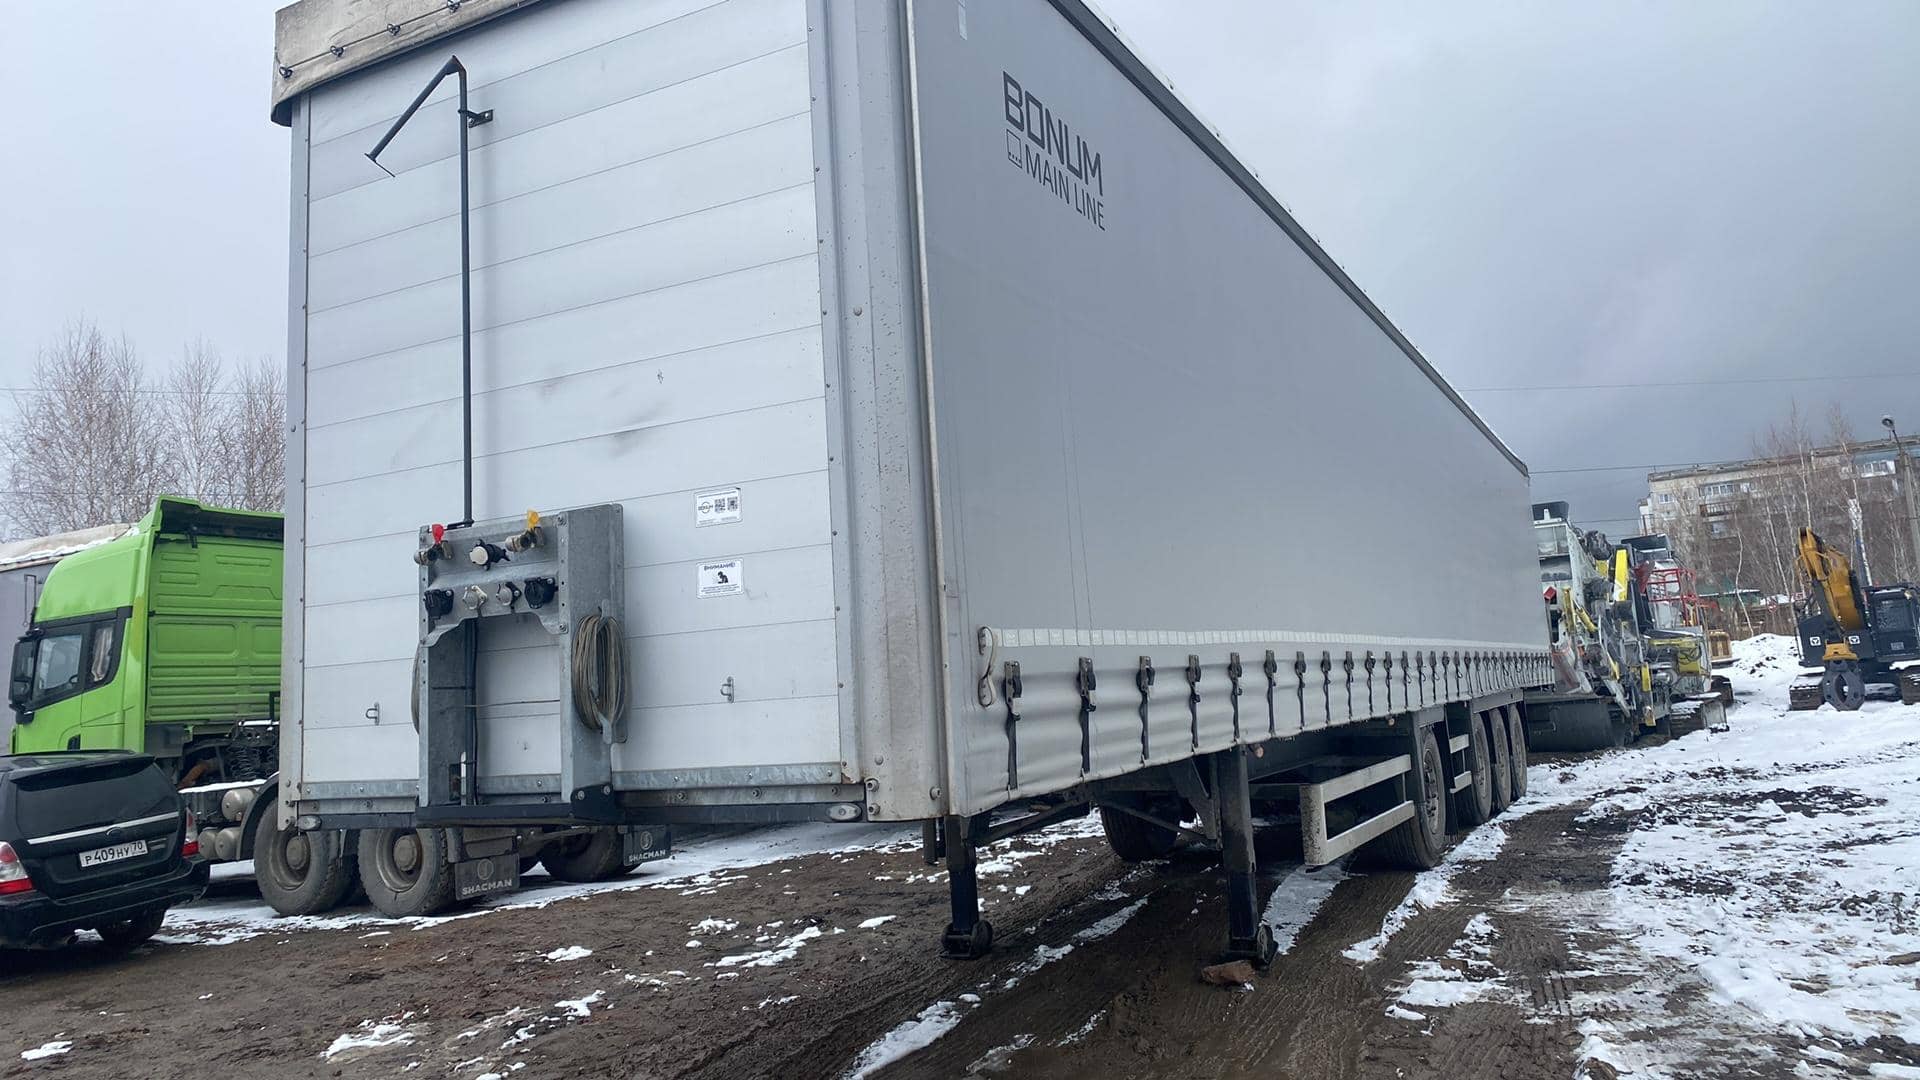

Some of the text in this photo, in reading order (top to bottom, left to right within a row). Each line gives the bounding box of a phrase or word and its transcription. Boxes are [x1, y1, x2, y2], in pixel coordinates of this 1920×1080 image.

[1003, 71, 1103, 197] BONUM
[1025, 144, 1106, 231] MAIN LINE
[628, 850, 666, 863] SHACMAN
[462, 879, 513, 895] SHACMAN
